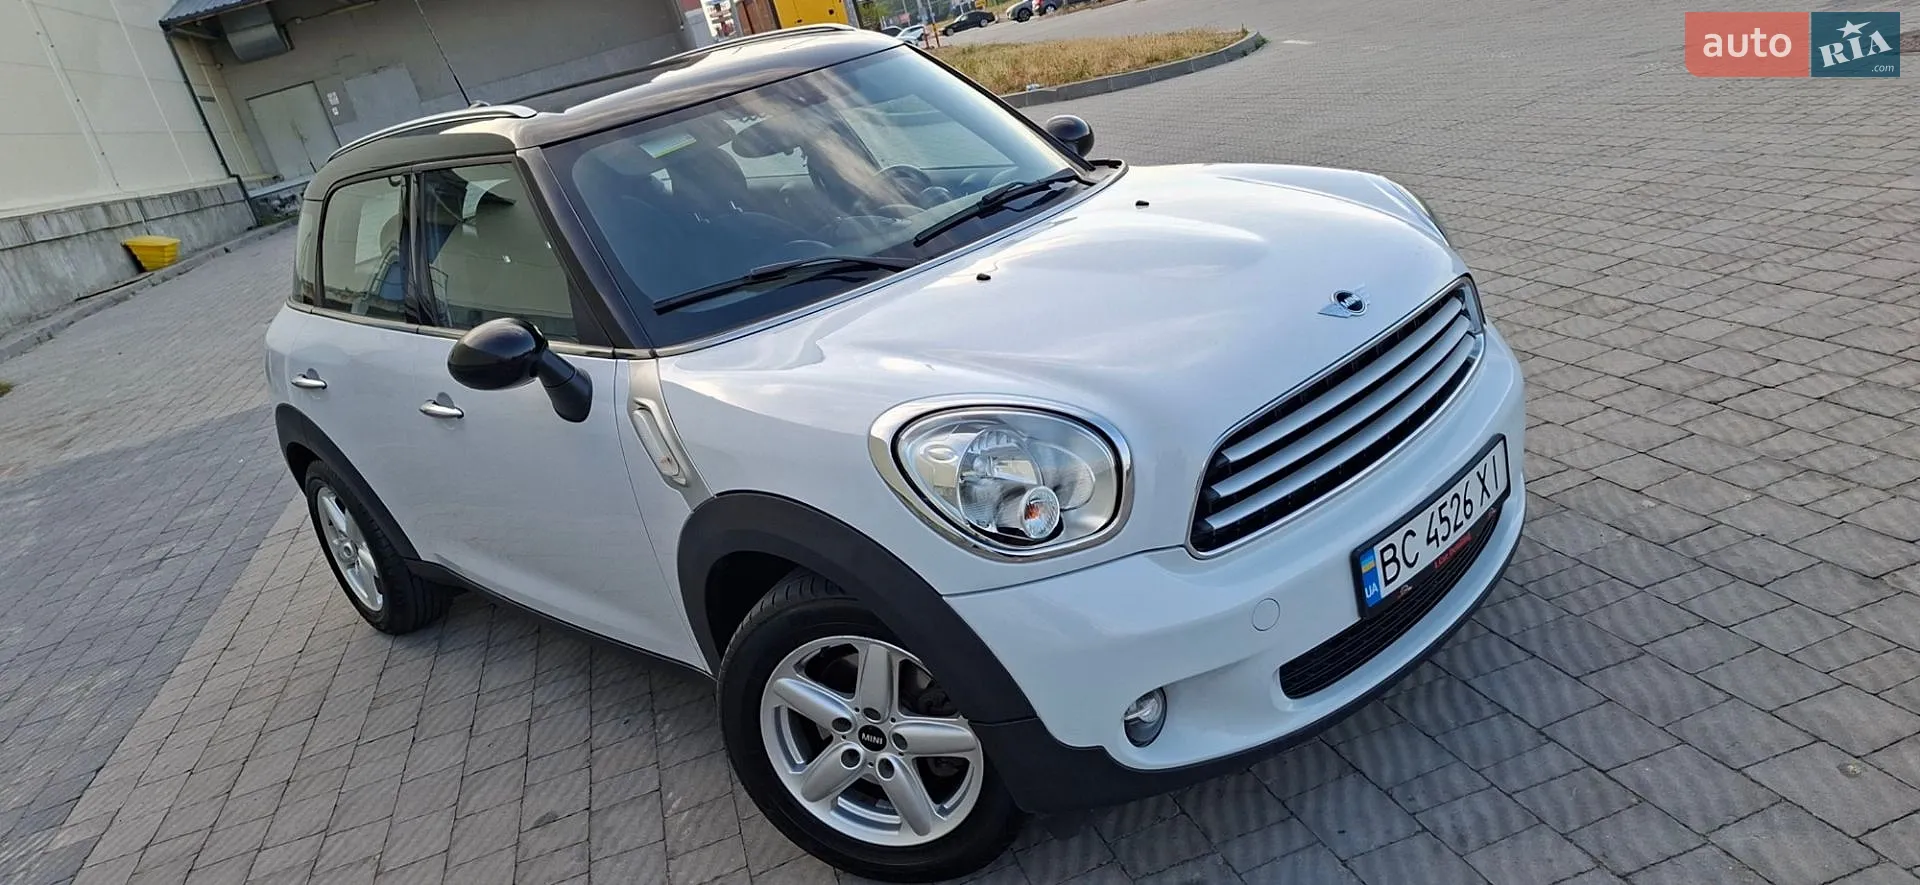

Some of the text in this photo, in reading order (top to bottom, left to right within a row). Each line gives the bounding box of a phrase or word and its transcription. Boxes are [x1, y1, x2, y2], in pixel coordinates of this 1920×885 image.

[1379, 529, 1420, 588] BC
[1426, 481, 1474, 548] 4526
[1476, 455, 1498, 507] XI
[1364, 582, 1379, 599] UA
[861, 732, 883, 745] MINI
